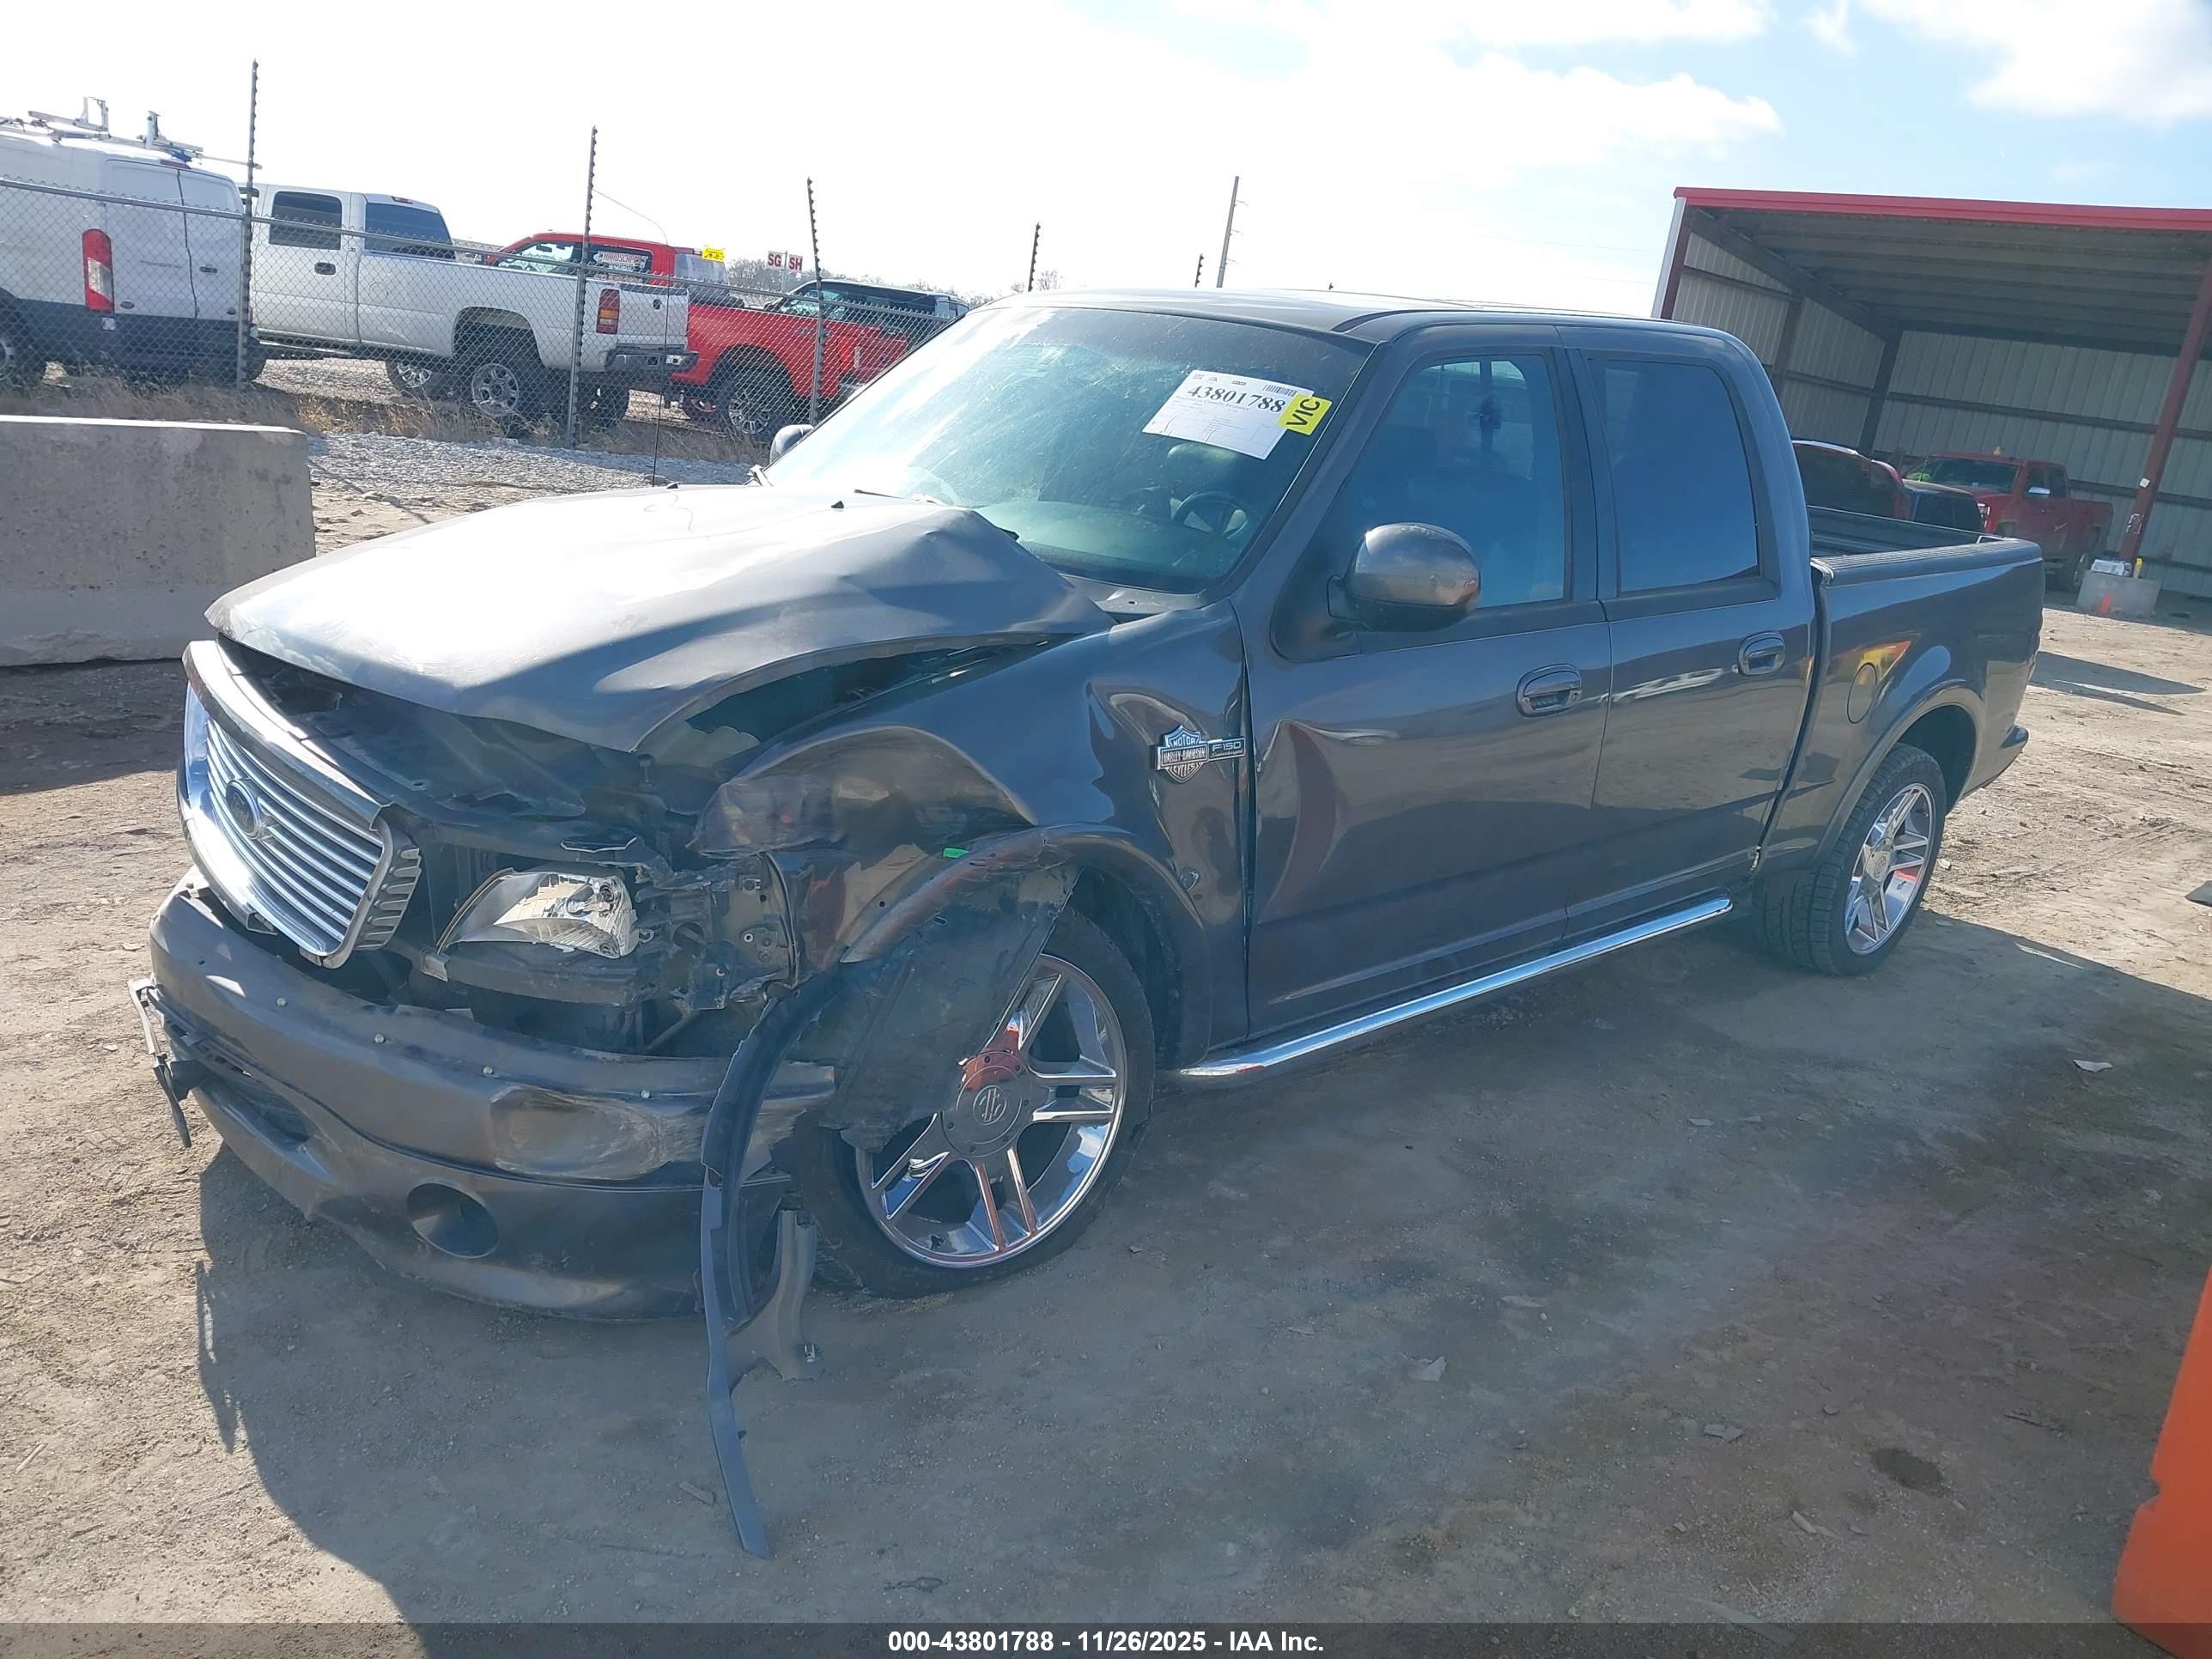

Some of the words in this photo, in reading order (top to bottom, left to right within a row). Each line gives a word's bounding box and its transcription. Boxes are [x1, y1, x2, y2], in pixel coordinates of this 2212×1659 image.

[768, 253, 781, 267] SG
[788, 257, 803, 271] SH
[1188, 385, 1286, 413] 43801788
[1285, 398, 1321, 427] VIC
[1173, 736, 1195, 748] MOTOR
[1212, 741, 1242, 752] F150
[1163, 746, 1206, 763] HARLEY-DAVIDSON
[1173, 763, 1195, 777] CYCLES
